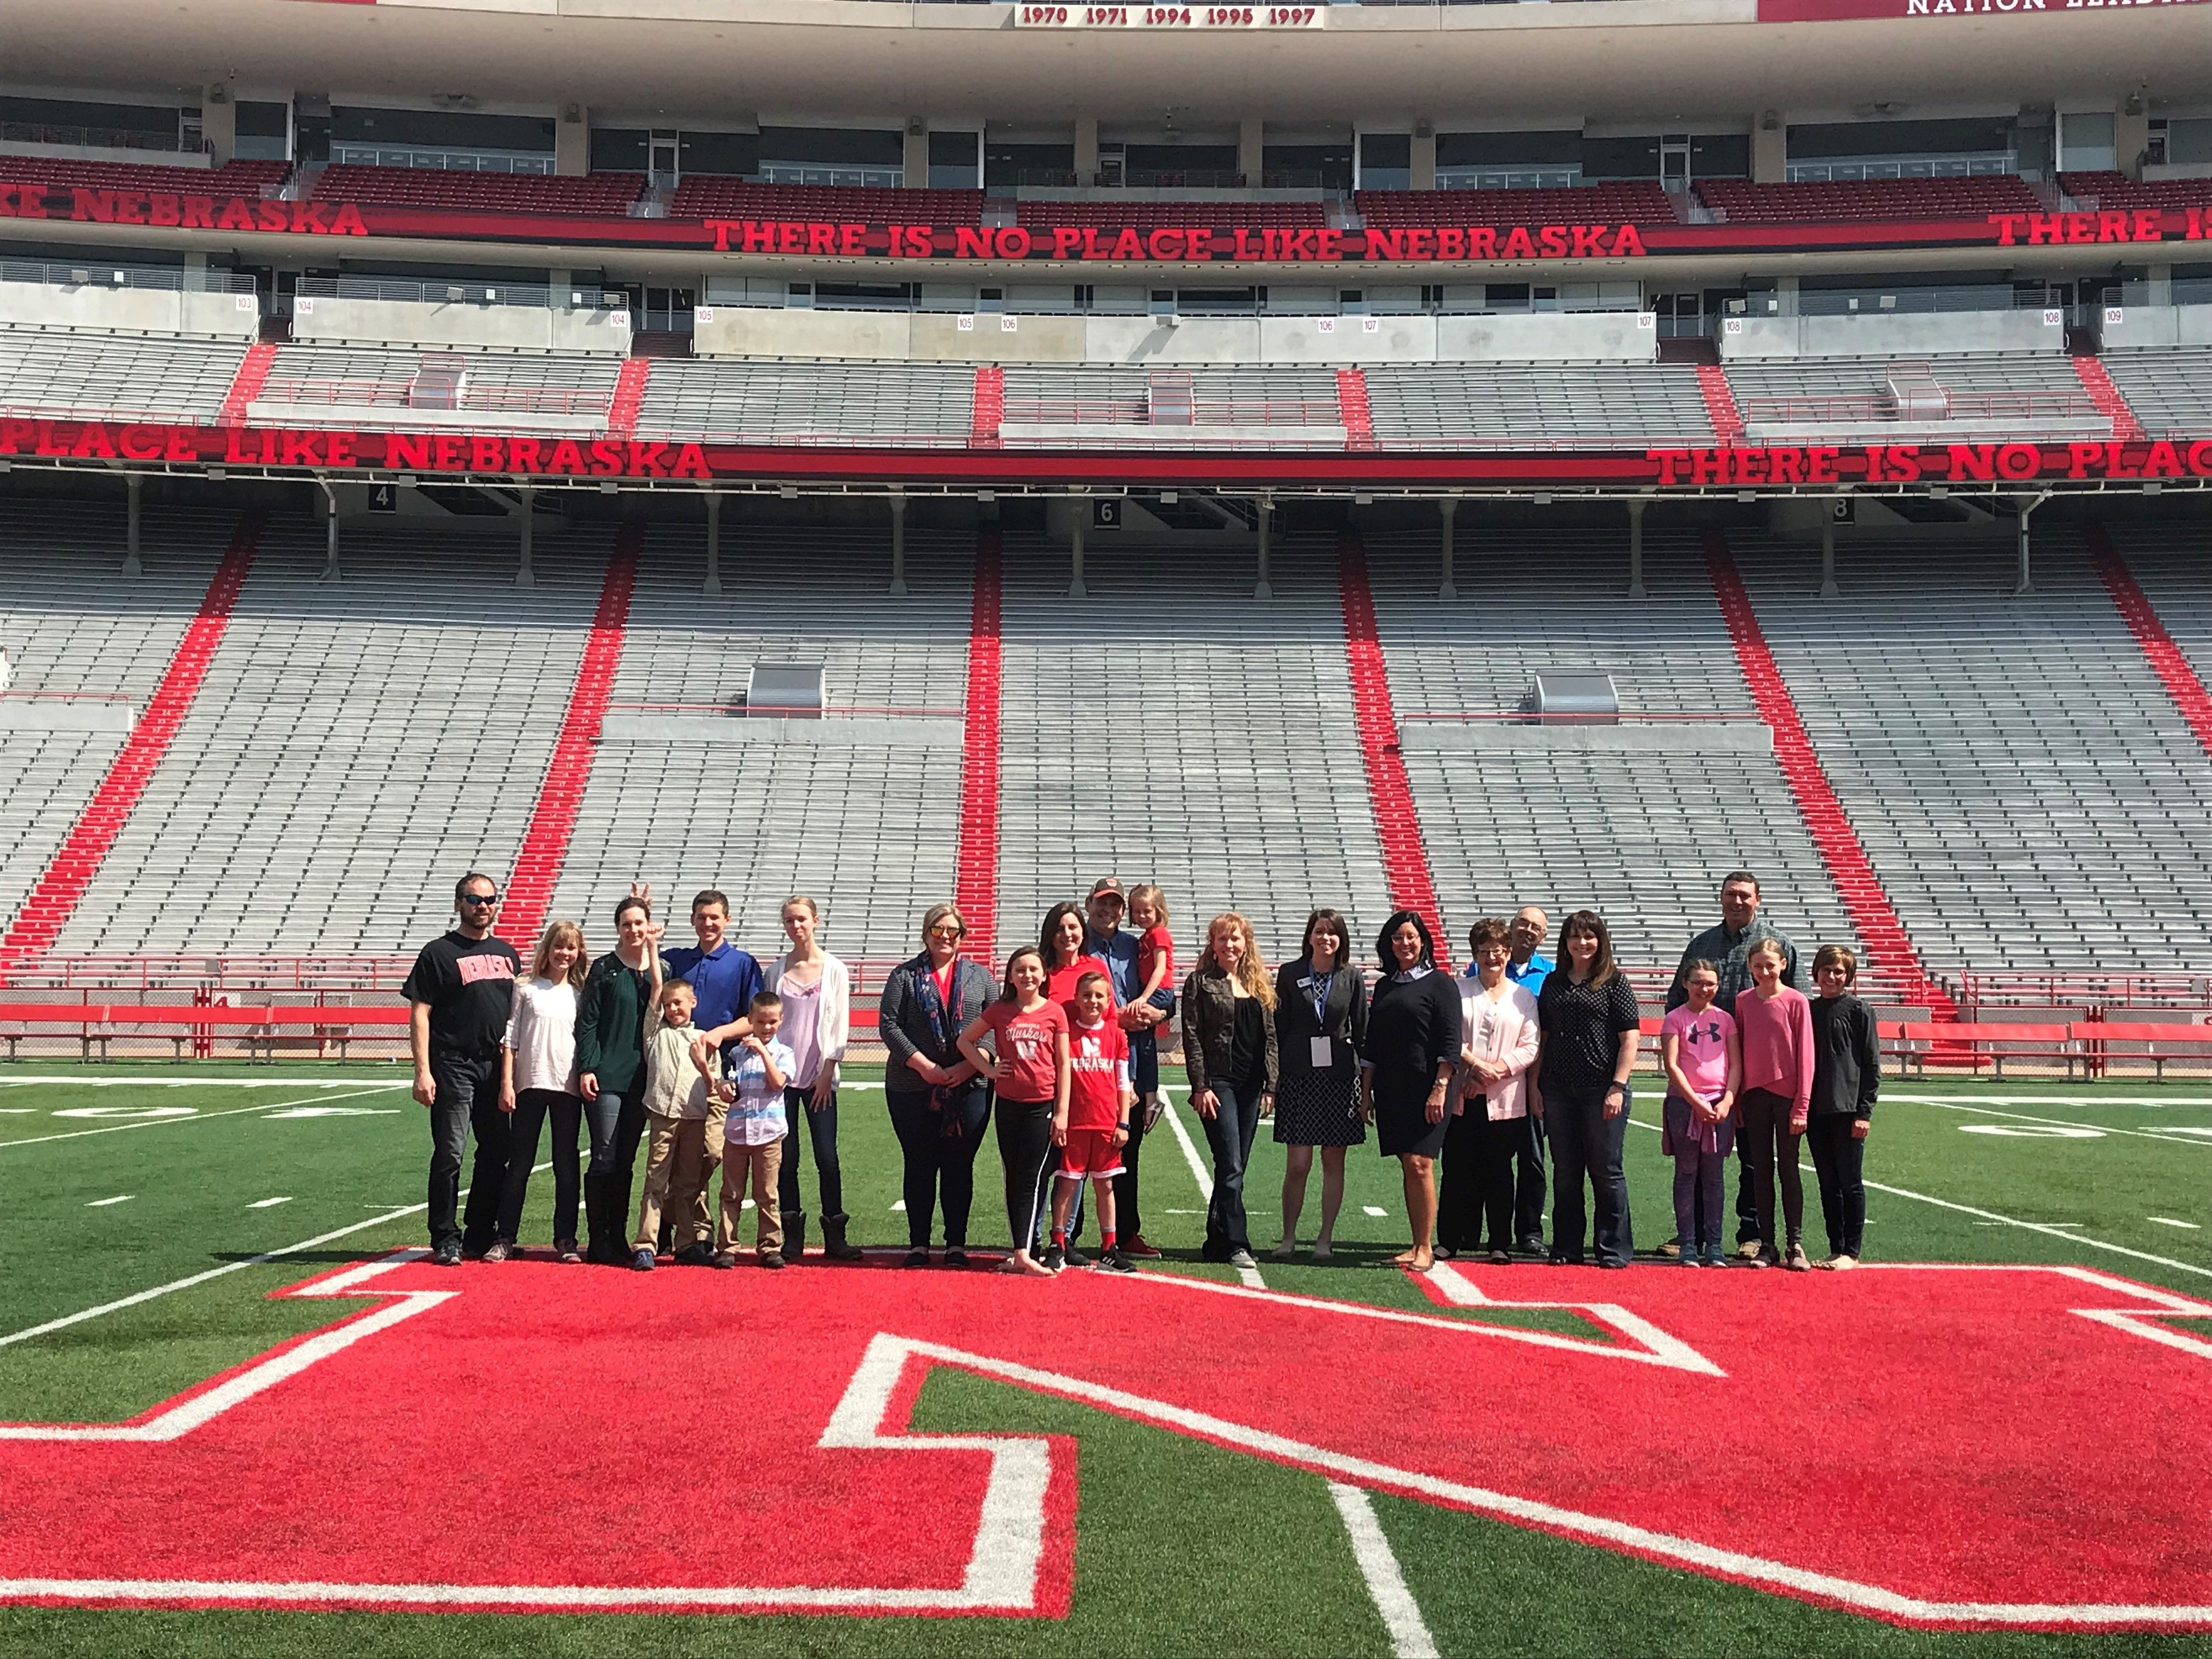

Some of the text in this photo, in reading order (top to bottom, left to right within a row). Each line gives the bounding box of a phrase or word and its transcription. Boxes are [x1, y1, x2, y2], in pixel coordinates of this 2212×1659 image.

[1023, 7, 1315, 25] 1970 1971 1994 1995 1997
[72, 188, 368, 236] NEBRASKA
[1987, 205, 2212, 246] THERE I
[703, 219, 1647, 261] THERE IS NO PLACE LIKE NEBRASKA
[238, 298, 251, 308] 103
[298, 301, 312, 311] 104
[611, 314, 625, 325] 104
[698, 310, 712, 321] 105
[1639, 315, 1651, 327] 107
[2045, 311, 2059, 323] 108
[2107, 310, 2121, 322] 109
[959, 318, 972, 328] 105
[1002, 318, 1015, 329] 106
[1319, 321, 1333, 331] 106
[1365, 321, 1376, 331] 107
[1726, 320, 1740, 332] 108
[0, 417, 713, 478] PLACE LIKE NEBRASKA
[1646, 440, 2212, 484] THERE IS NO PLAC
[376, 486, 388, 506] 4
[1101, 504, 1113, 521] 6
[1834, 499, 1848, 517] 8
